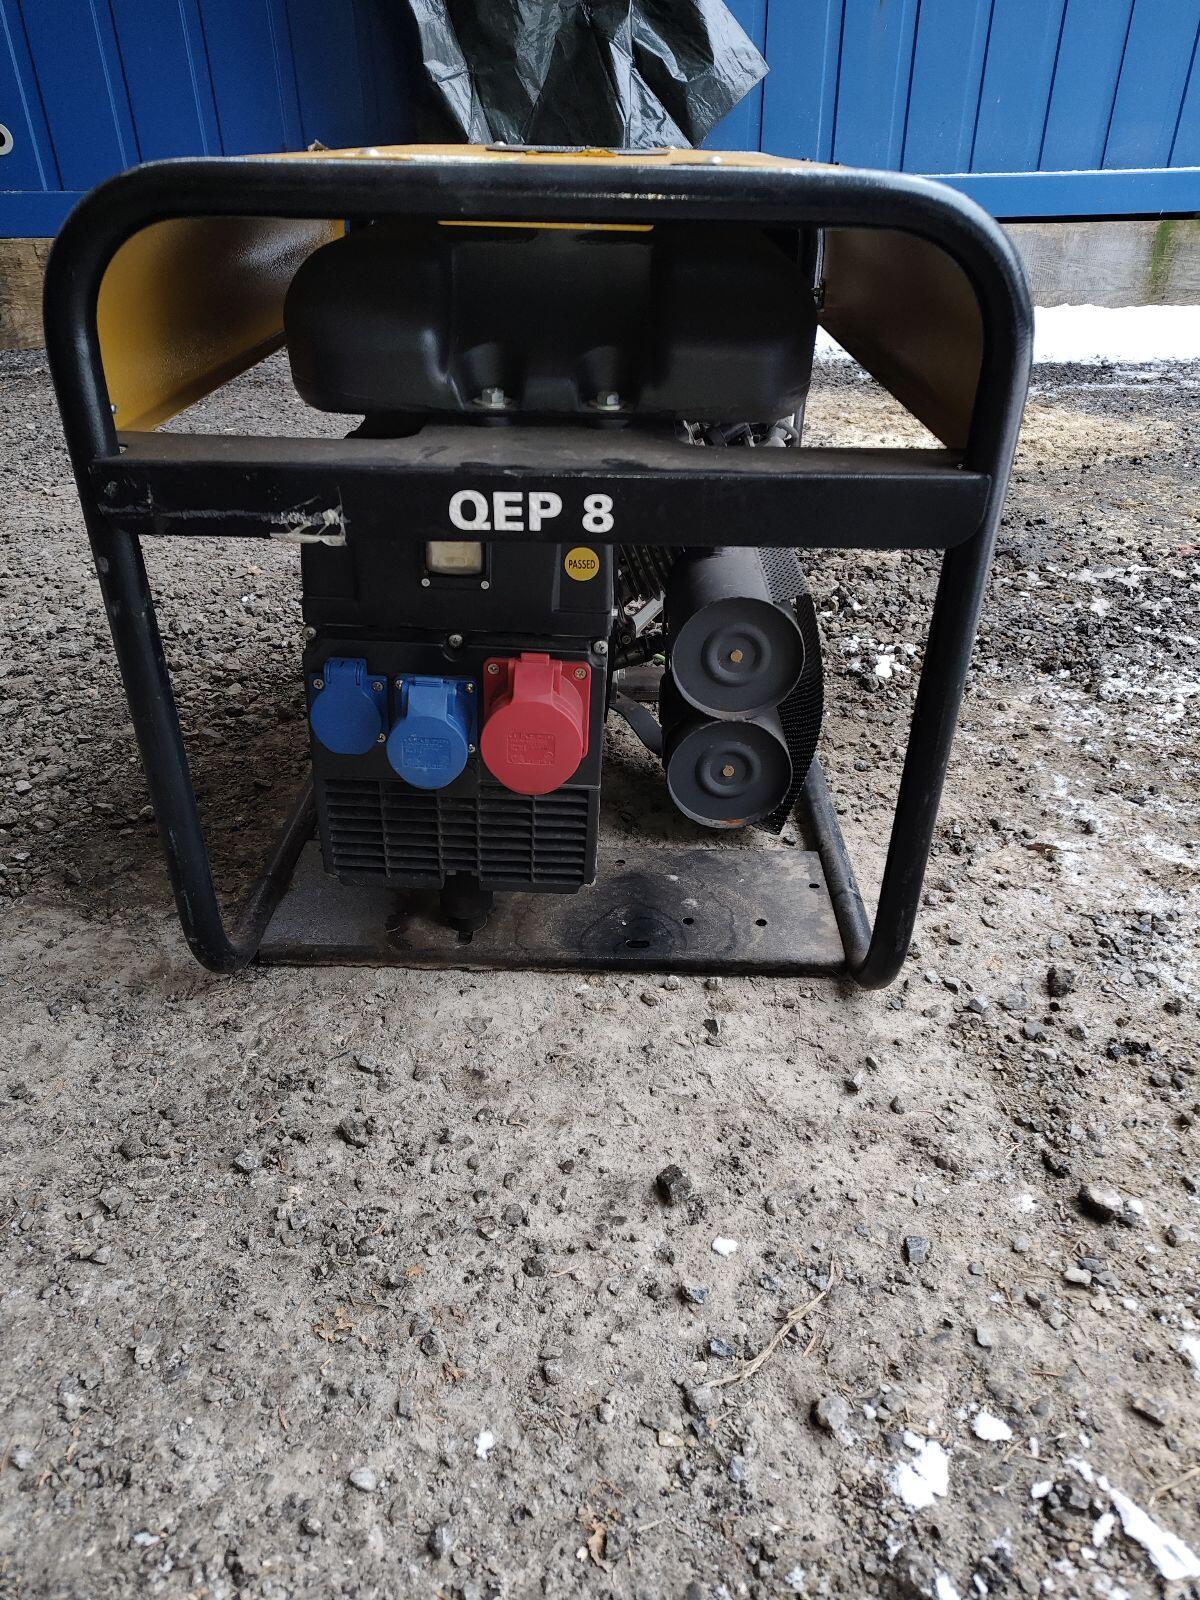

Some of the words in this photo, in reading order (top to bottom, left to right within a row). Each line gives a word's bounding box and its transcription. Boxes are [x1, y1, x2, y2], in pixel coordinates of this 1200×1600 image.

[449, 490, 562, 531] QEP
[582, 493, 614, 533] 8
[568, 559, 596, 570] PASSED
